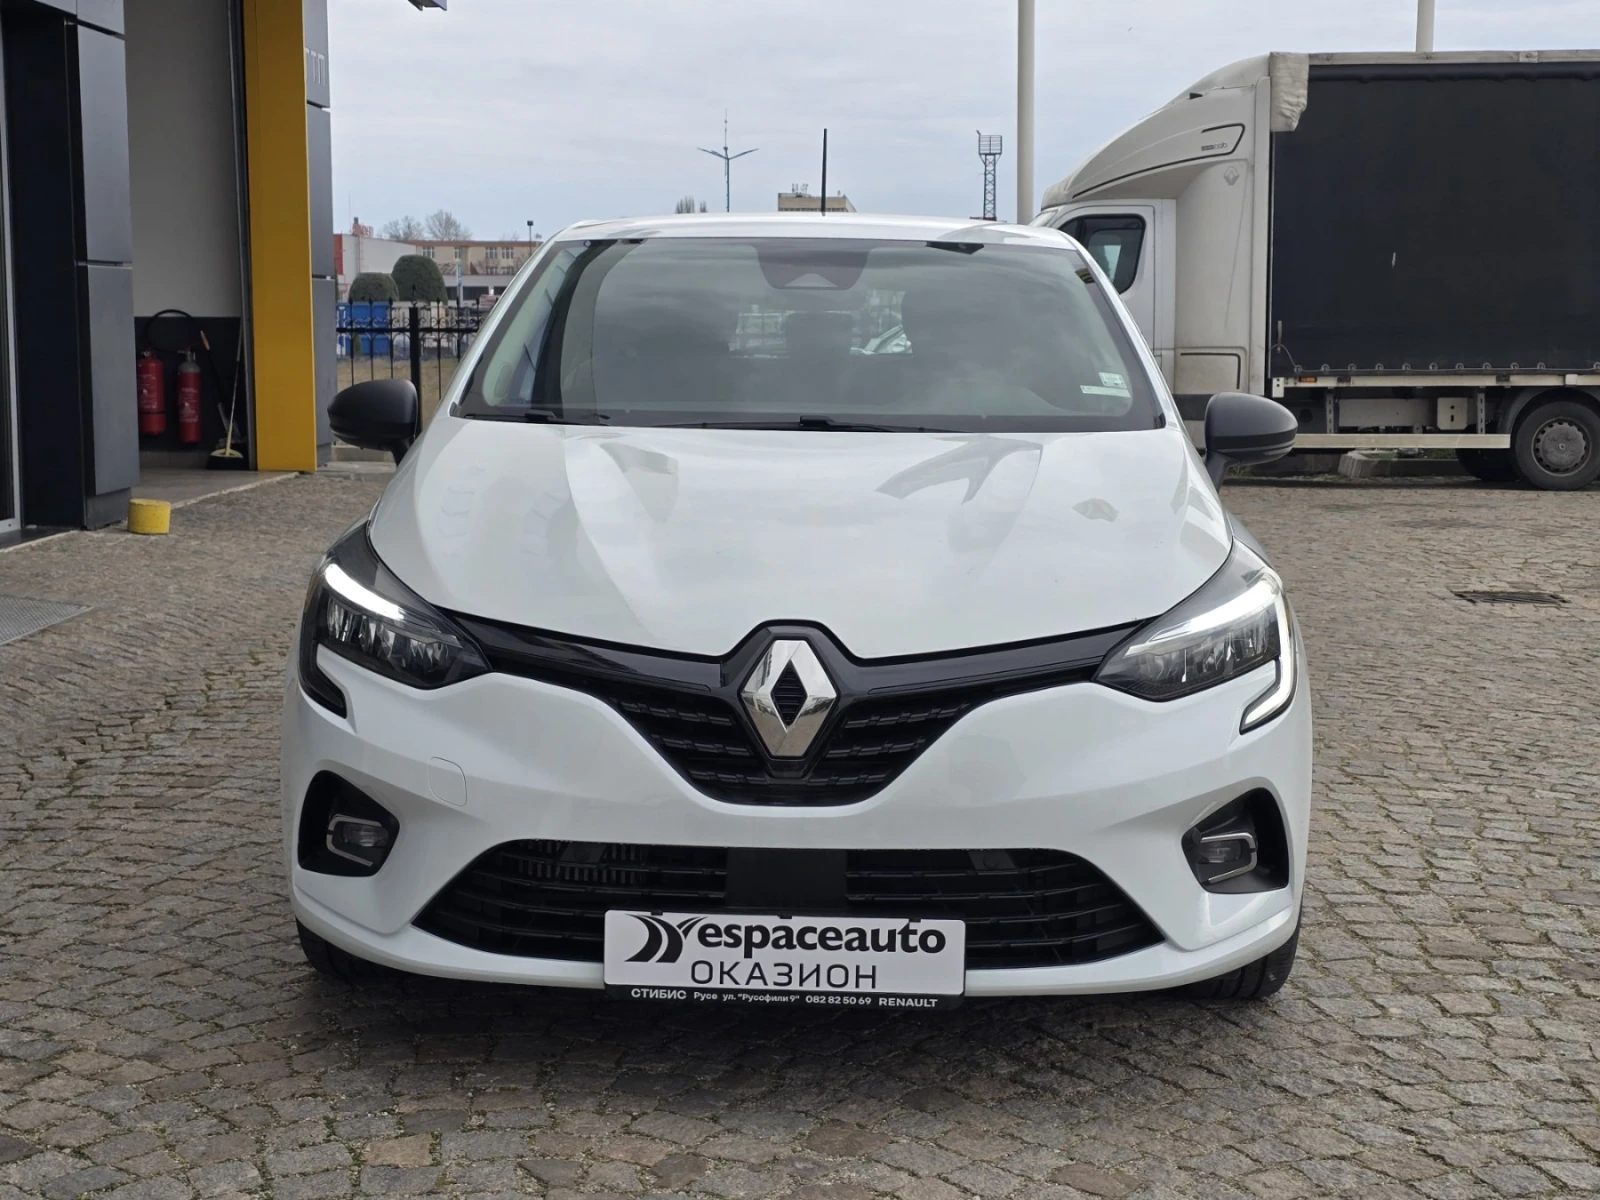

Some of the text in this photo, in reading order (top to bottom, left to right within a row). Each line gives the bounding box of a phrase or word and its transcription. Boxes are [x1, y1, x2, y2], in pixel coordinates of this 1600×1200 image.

[697, 922, 947, 959] espaceauto
[690, 960, 877, 989] ОКАЗИОН
[631, 988, 687, 1000] СТИБИС
[693, 991, 719, 1001] Русе
[878, 997, 938, 1008] RENAULT
